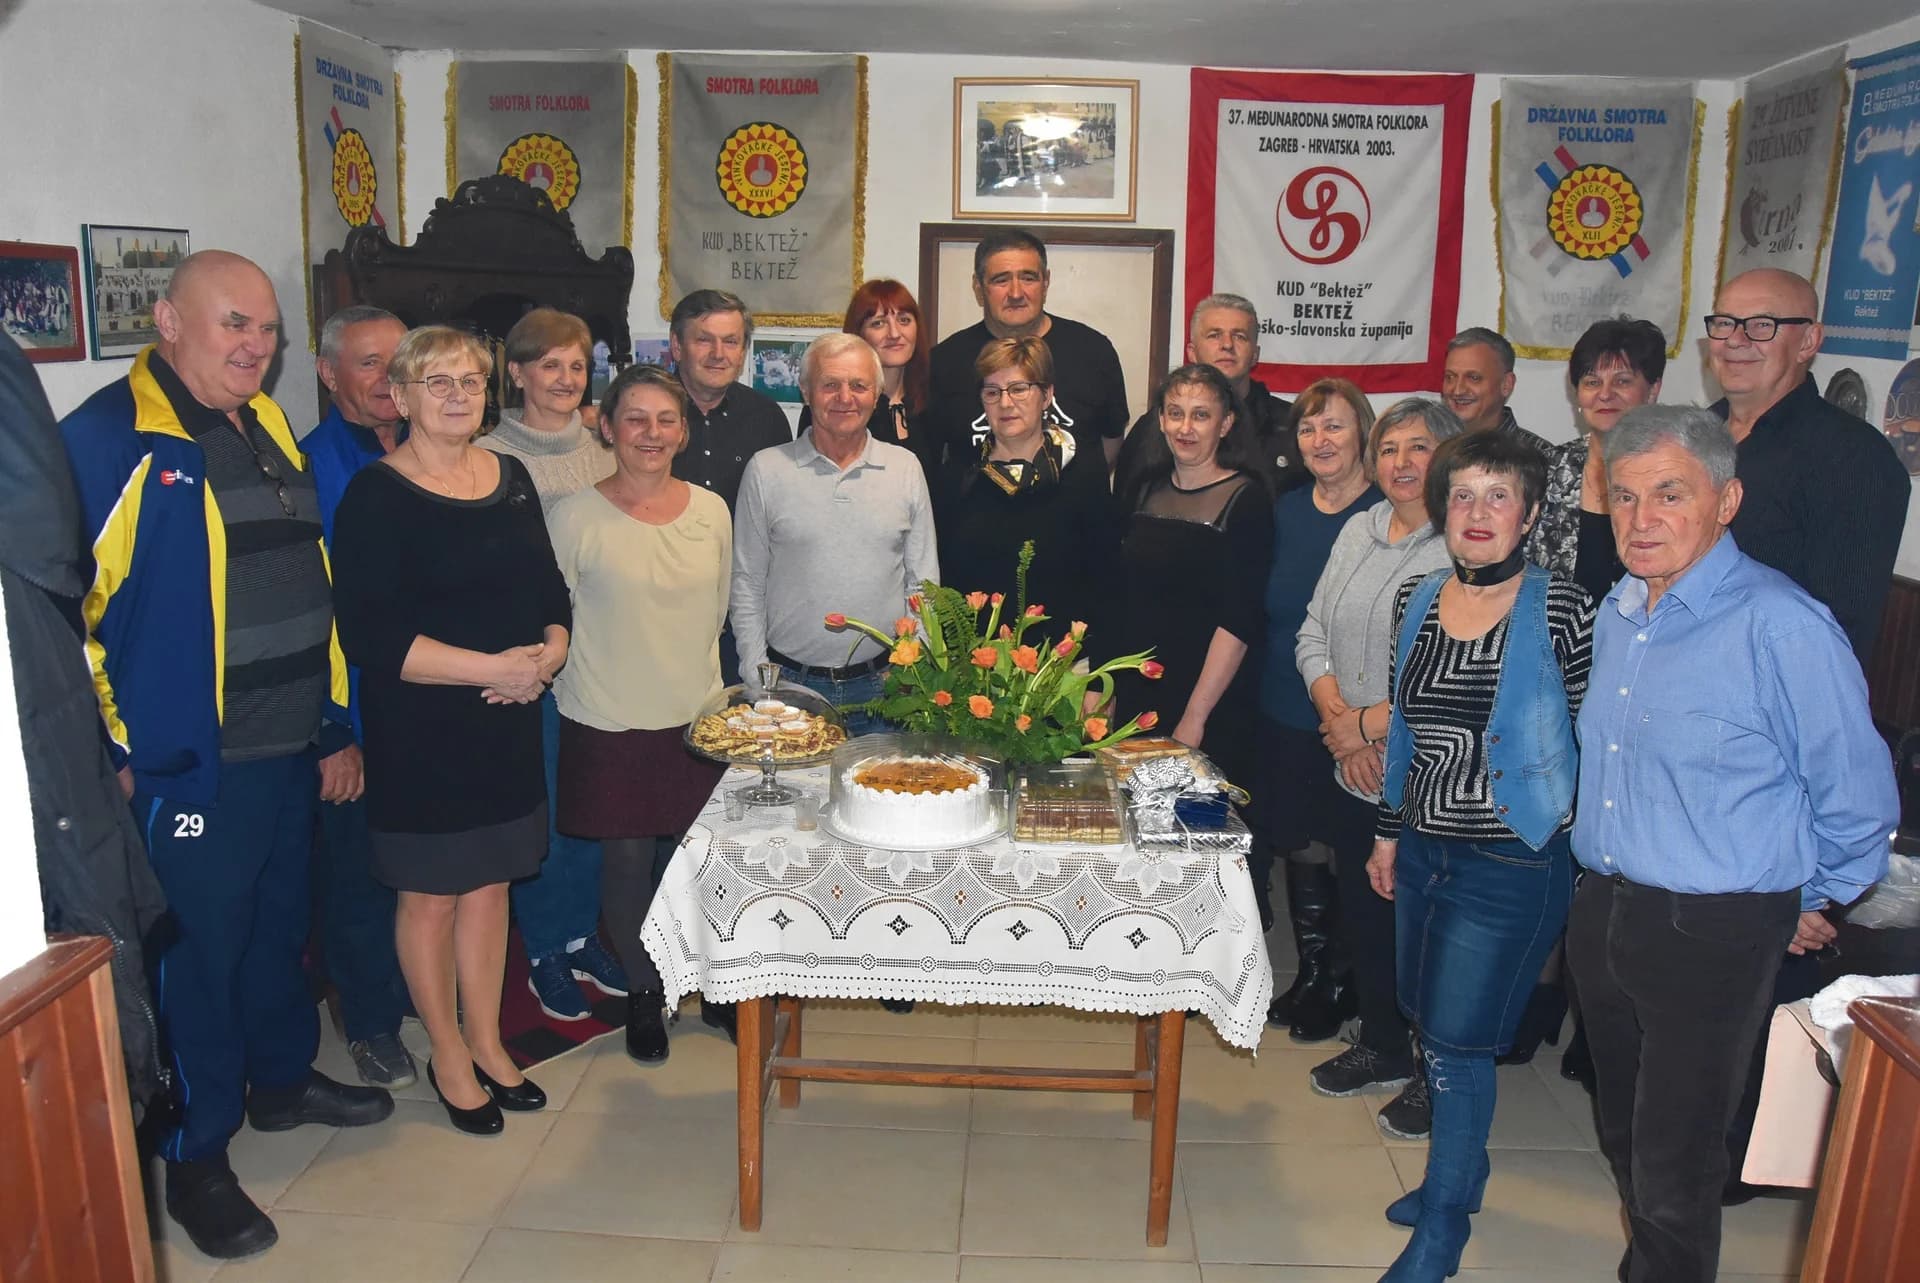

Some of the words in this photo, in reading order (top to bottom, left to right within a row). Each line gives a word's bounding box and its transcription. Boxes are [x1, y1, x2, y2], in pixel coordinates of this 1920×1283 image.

[356, 72, 384, 96] SMOTRA
[707, 76, 754, 95] SMOTRA
[759, 77, 819, 96] FOLKLORA
[333, 83, 370, 110] FOLKLORA
[489, 95, 532, 111] SMOTRA
[535, 95, 591, 112] FOLKLORA
[1228, 109, 1244, 125] 37.
[1247, 111, 1329, 128] MEĐUNARODNA
[1332, 113, 1373, 129] SMOTRA
[1376, 113, 1429, 130] FOLKLORA
[1527, 104, 1597, 125] DRŽAVNA
[1603, 108, 1667, 125] SMOTRA
[1558, 126, 1635, 143] FOLKLORA
[1259, 137, 1299, 153] ZAGREB
[1308, 139, 1360, 156] HRVATSKA
[1366, 140, 1395, 157] 2003.
[515, 150, 551, 178] NKOVAČKE
[749, 188, 774, 198] XXXVI
[1582, 231, 1601, 241] XLII
[731, 256, 800, 280] BEKTEŽ
[1276, 281, 1305, 297] KUD
[1293, 301, 1354, 320] BEKTEŽ
[1256, 319, 1356, 338] eško-slavonska
[1360, 320, 1414, 340] županija
[174, 813, 205, 838] 29
